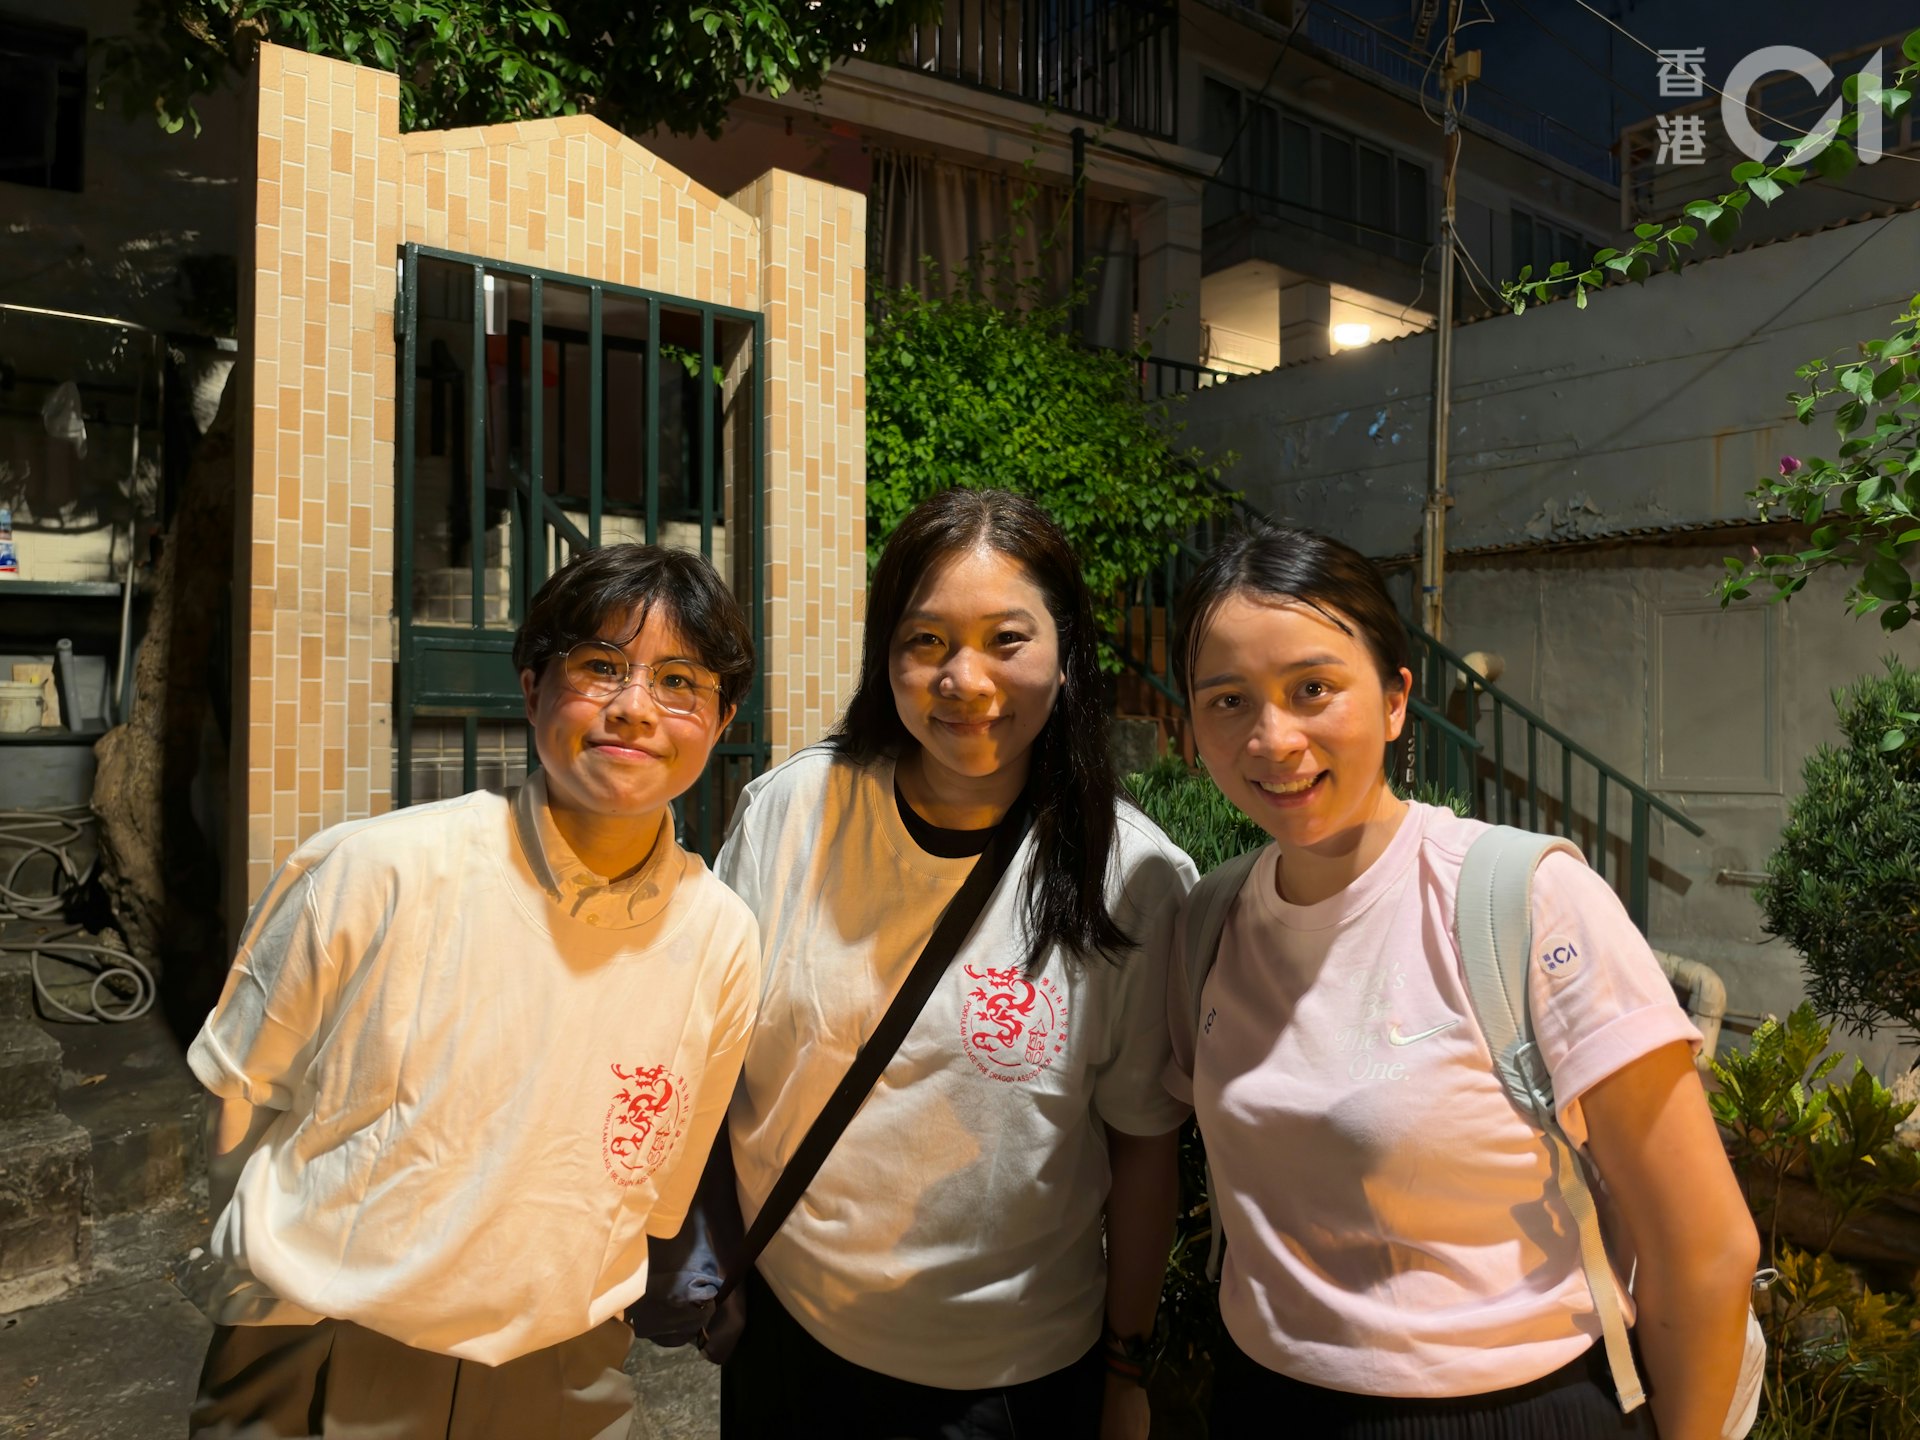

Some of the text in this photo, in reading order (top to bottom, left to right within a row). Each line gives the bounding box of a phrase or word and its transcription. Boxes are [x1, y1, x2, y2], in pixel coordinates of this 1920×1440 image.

[1349, 962, 1407, 994] Lt's
[962, 1037, 978, 1064] VILLAGE
[988, 1071, 1015, 1083] DRAGON
[1348, 1053, 1410, 1081] One.
